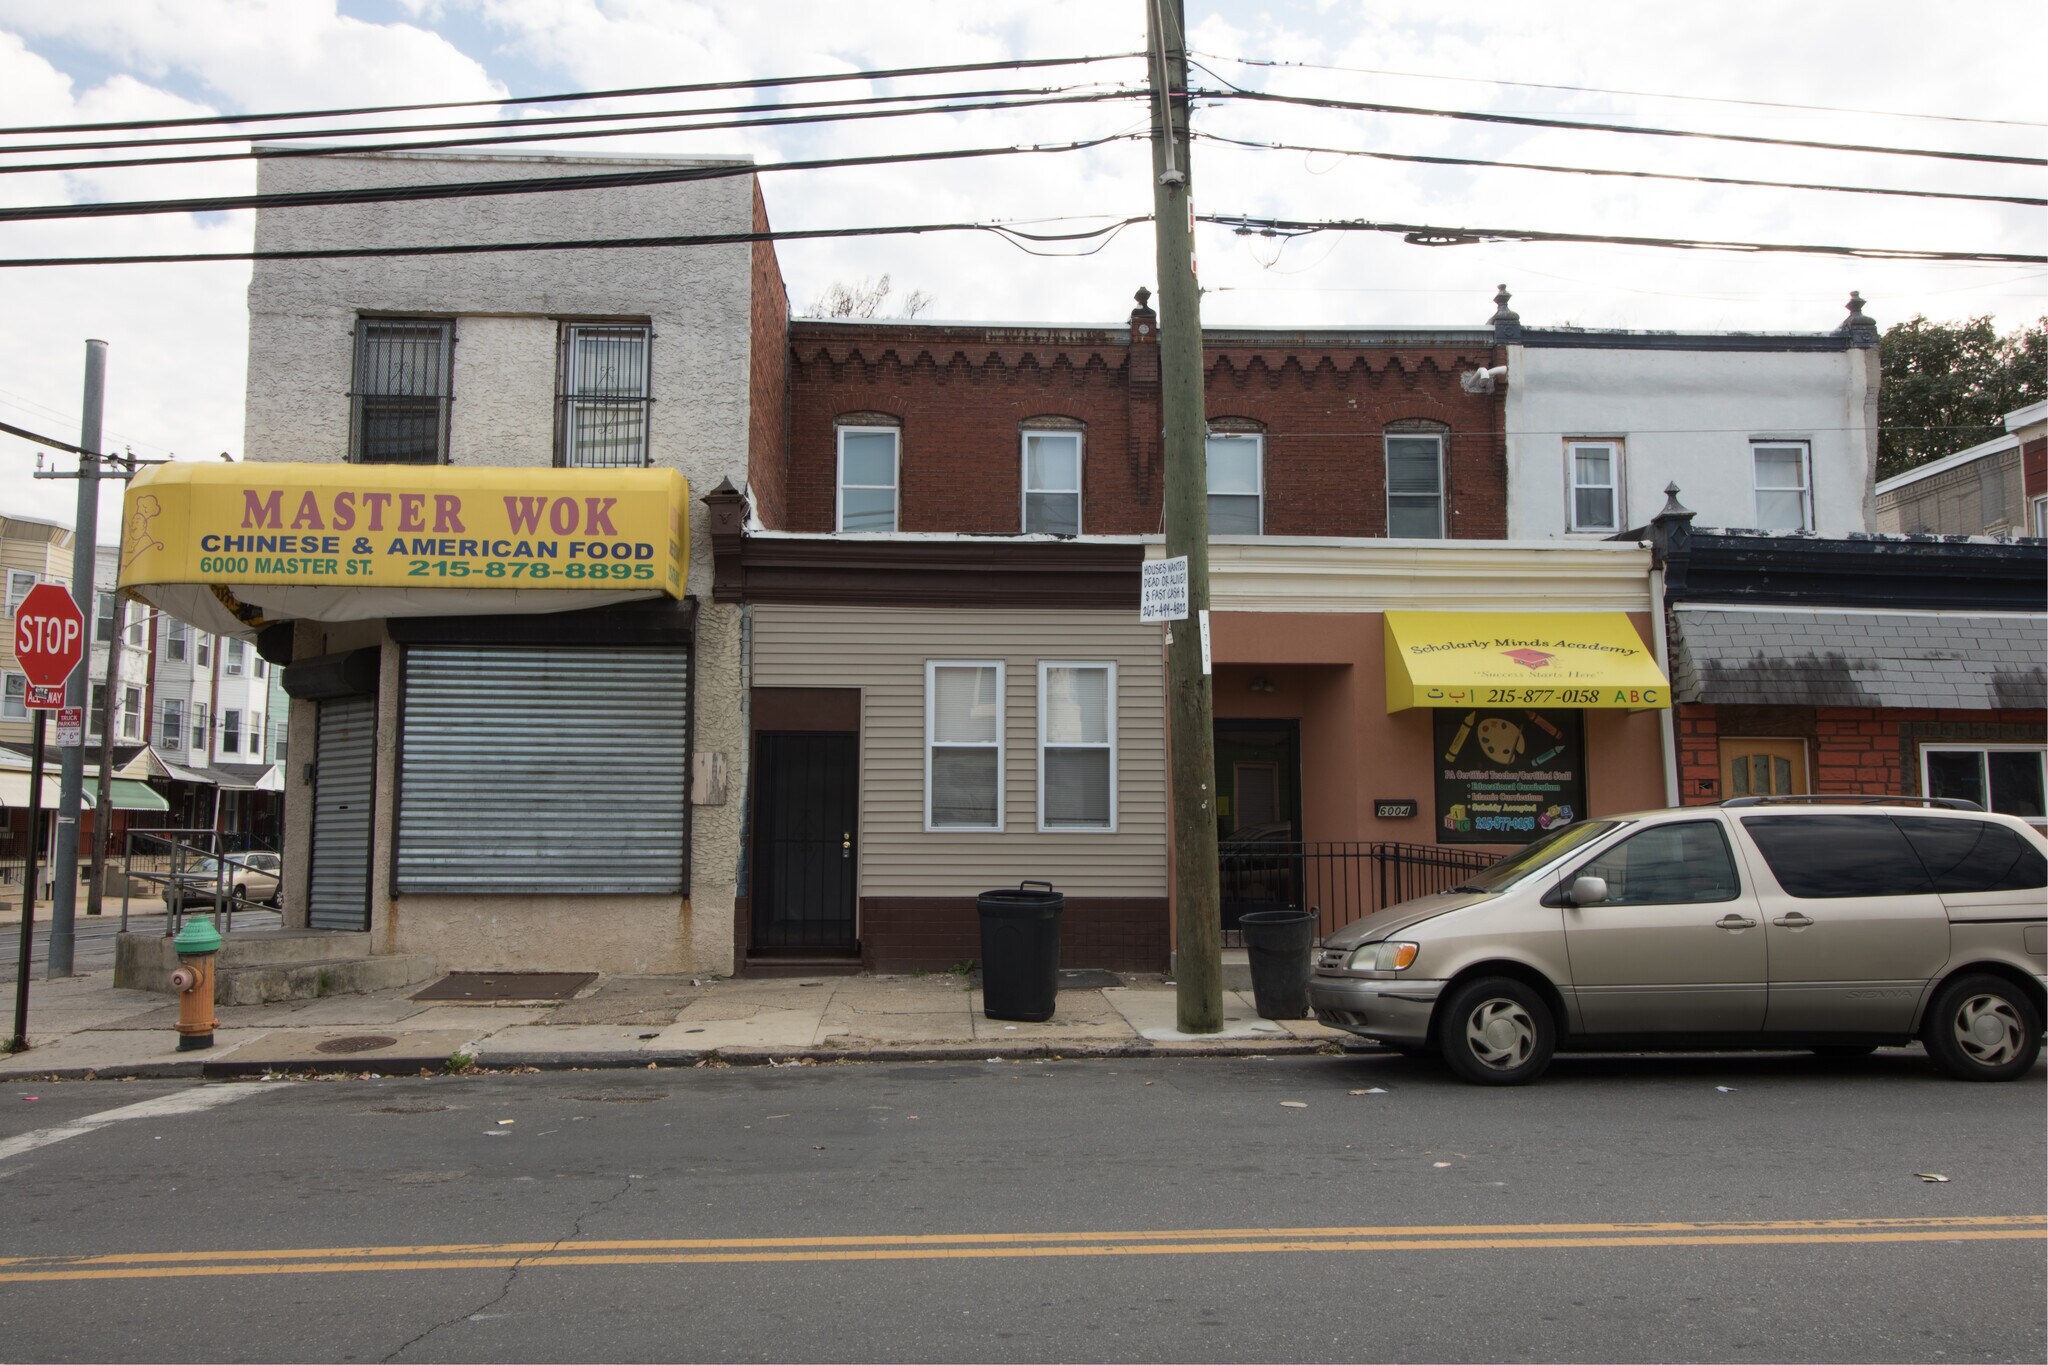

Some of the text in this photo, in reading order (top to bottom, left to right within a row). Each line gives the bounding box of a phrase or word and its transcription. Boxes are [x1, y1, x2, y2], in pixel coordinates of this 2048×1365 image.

[240, 489, 618, 537] MASTER WOK
[200, 535, 340, 554] CHINESE
[351, 536, 374, 555] &
[387, 538, 558, 559] AMERICAN
[569, 541, 654, 560] FOOD
[200, 556, 374, 576] 6000 MASTER ST.
[408, 560, 655, 580] 215-878-8895
[1144, 560, 1186, 576] HOUSES WANTED
[1144, 577, 1160, 588] DEAD
[1161, 575, 1169, 587] OR
[1152, 588, 1166, 601] FAST
[1167, 586, 1180, 599] CASH
[19, 614, 79, 655] STOP
[1410, 638, 1640, 657] Scholarly Minds Academy
[47, 692, 63, 704] WAY
[1487, 689, 1600, 704] 215-877-0158
[1471, 782, 1561, 792] Educational Curriculum
[1380, 806, 1409, 816] 6004
[1475, 816, 1535, 831] 215-877-0158
